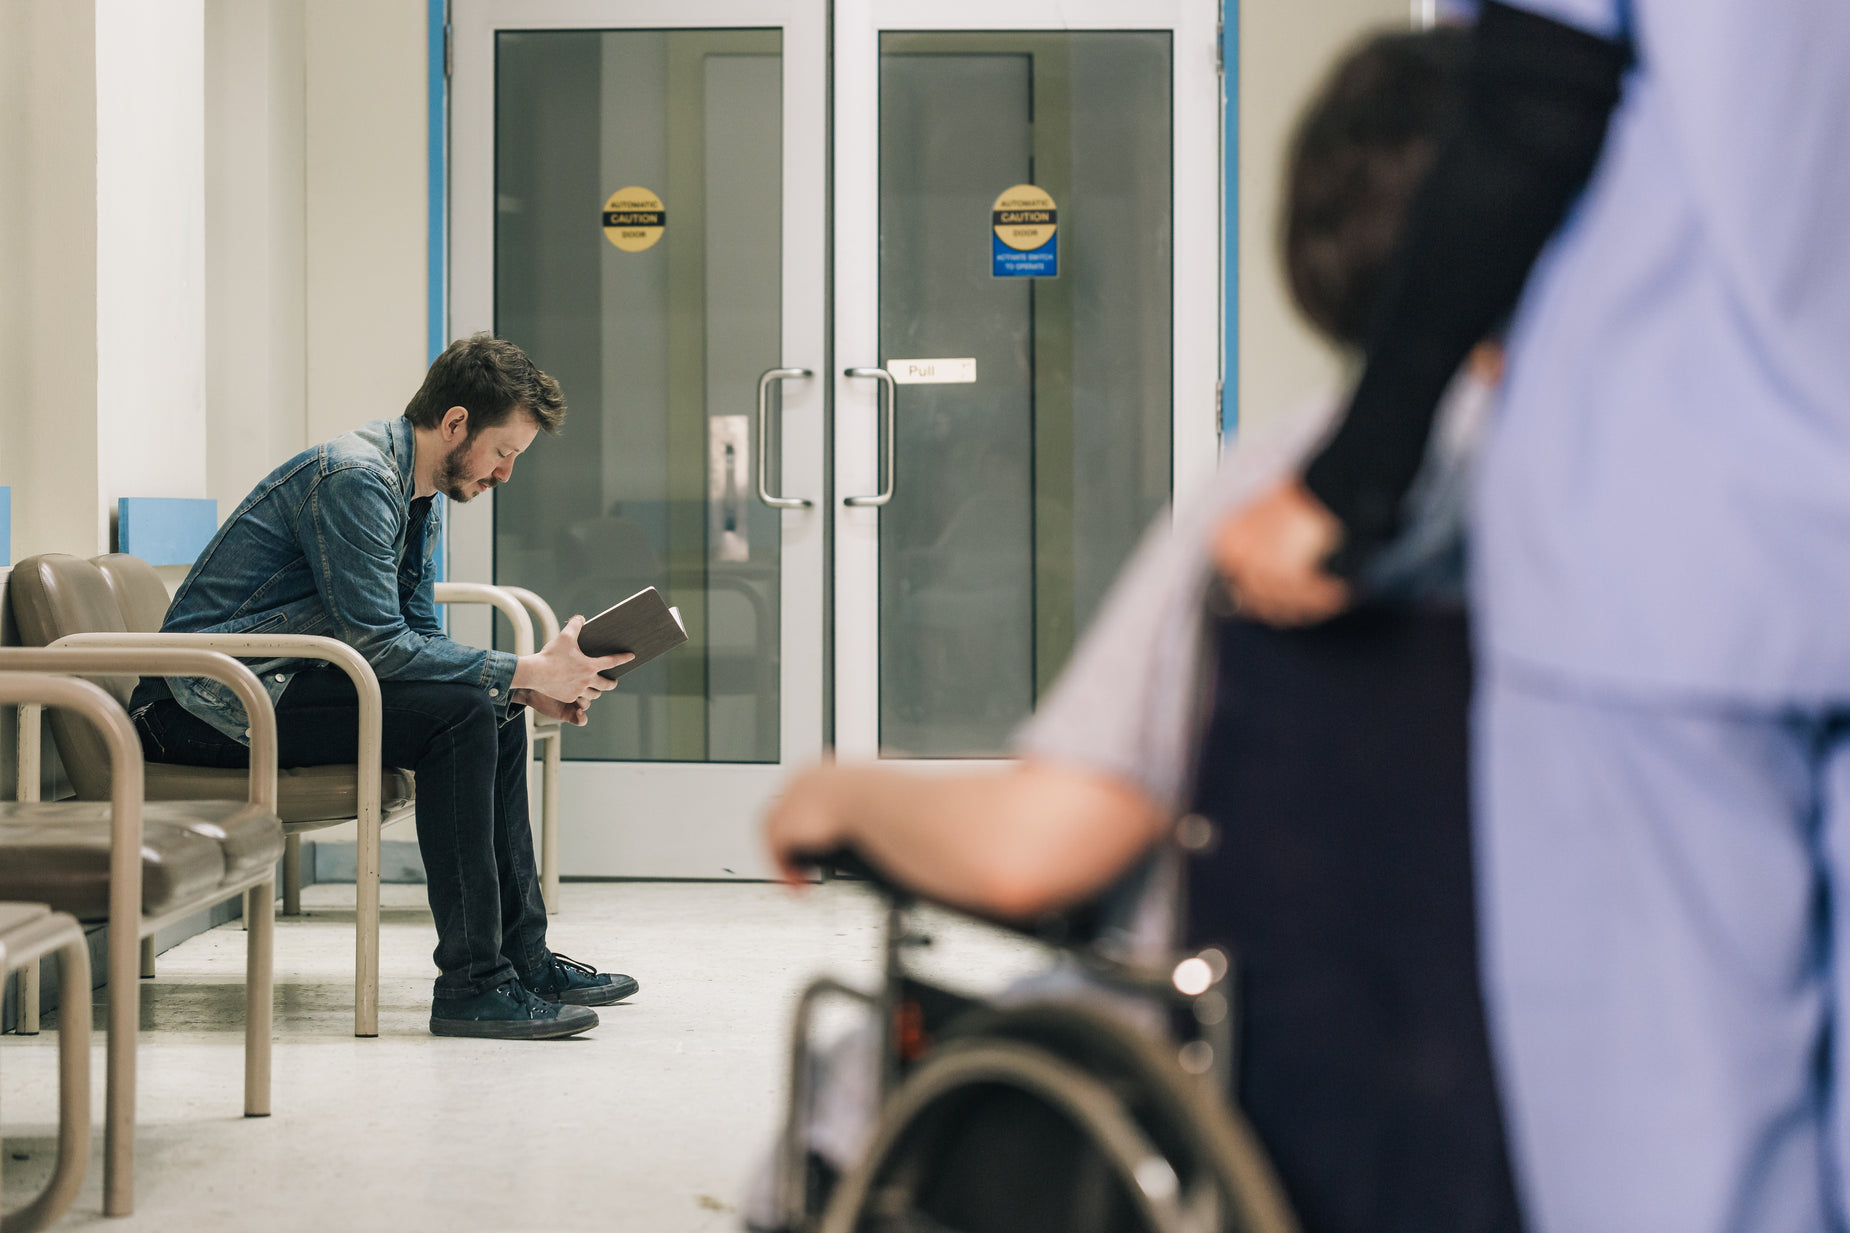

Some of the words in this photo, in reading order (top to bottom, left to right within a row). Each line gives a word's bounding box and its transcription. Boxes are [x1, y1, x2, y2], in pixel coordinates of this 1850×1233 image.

[611, 200, 657, 208] AUTOMATIC
[611, 214, 658, 224] CAUTION
[1001, 212, 1049, 222] CAUTION
[1013, 229, 1038, 237] DOOR
[909, 365, 935, 377] Pull
